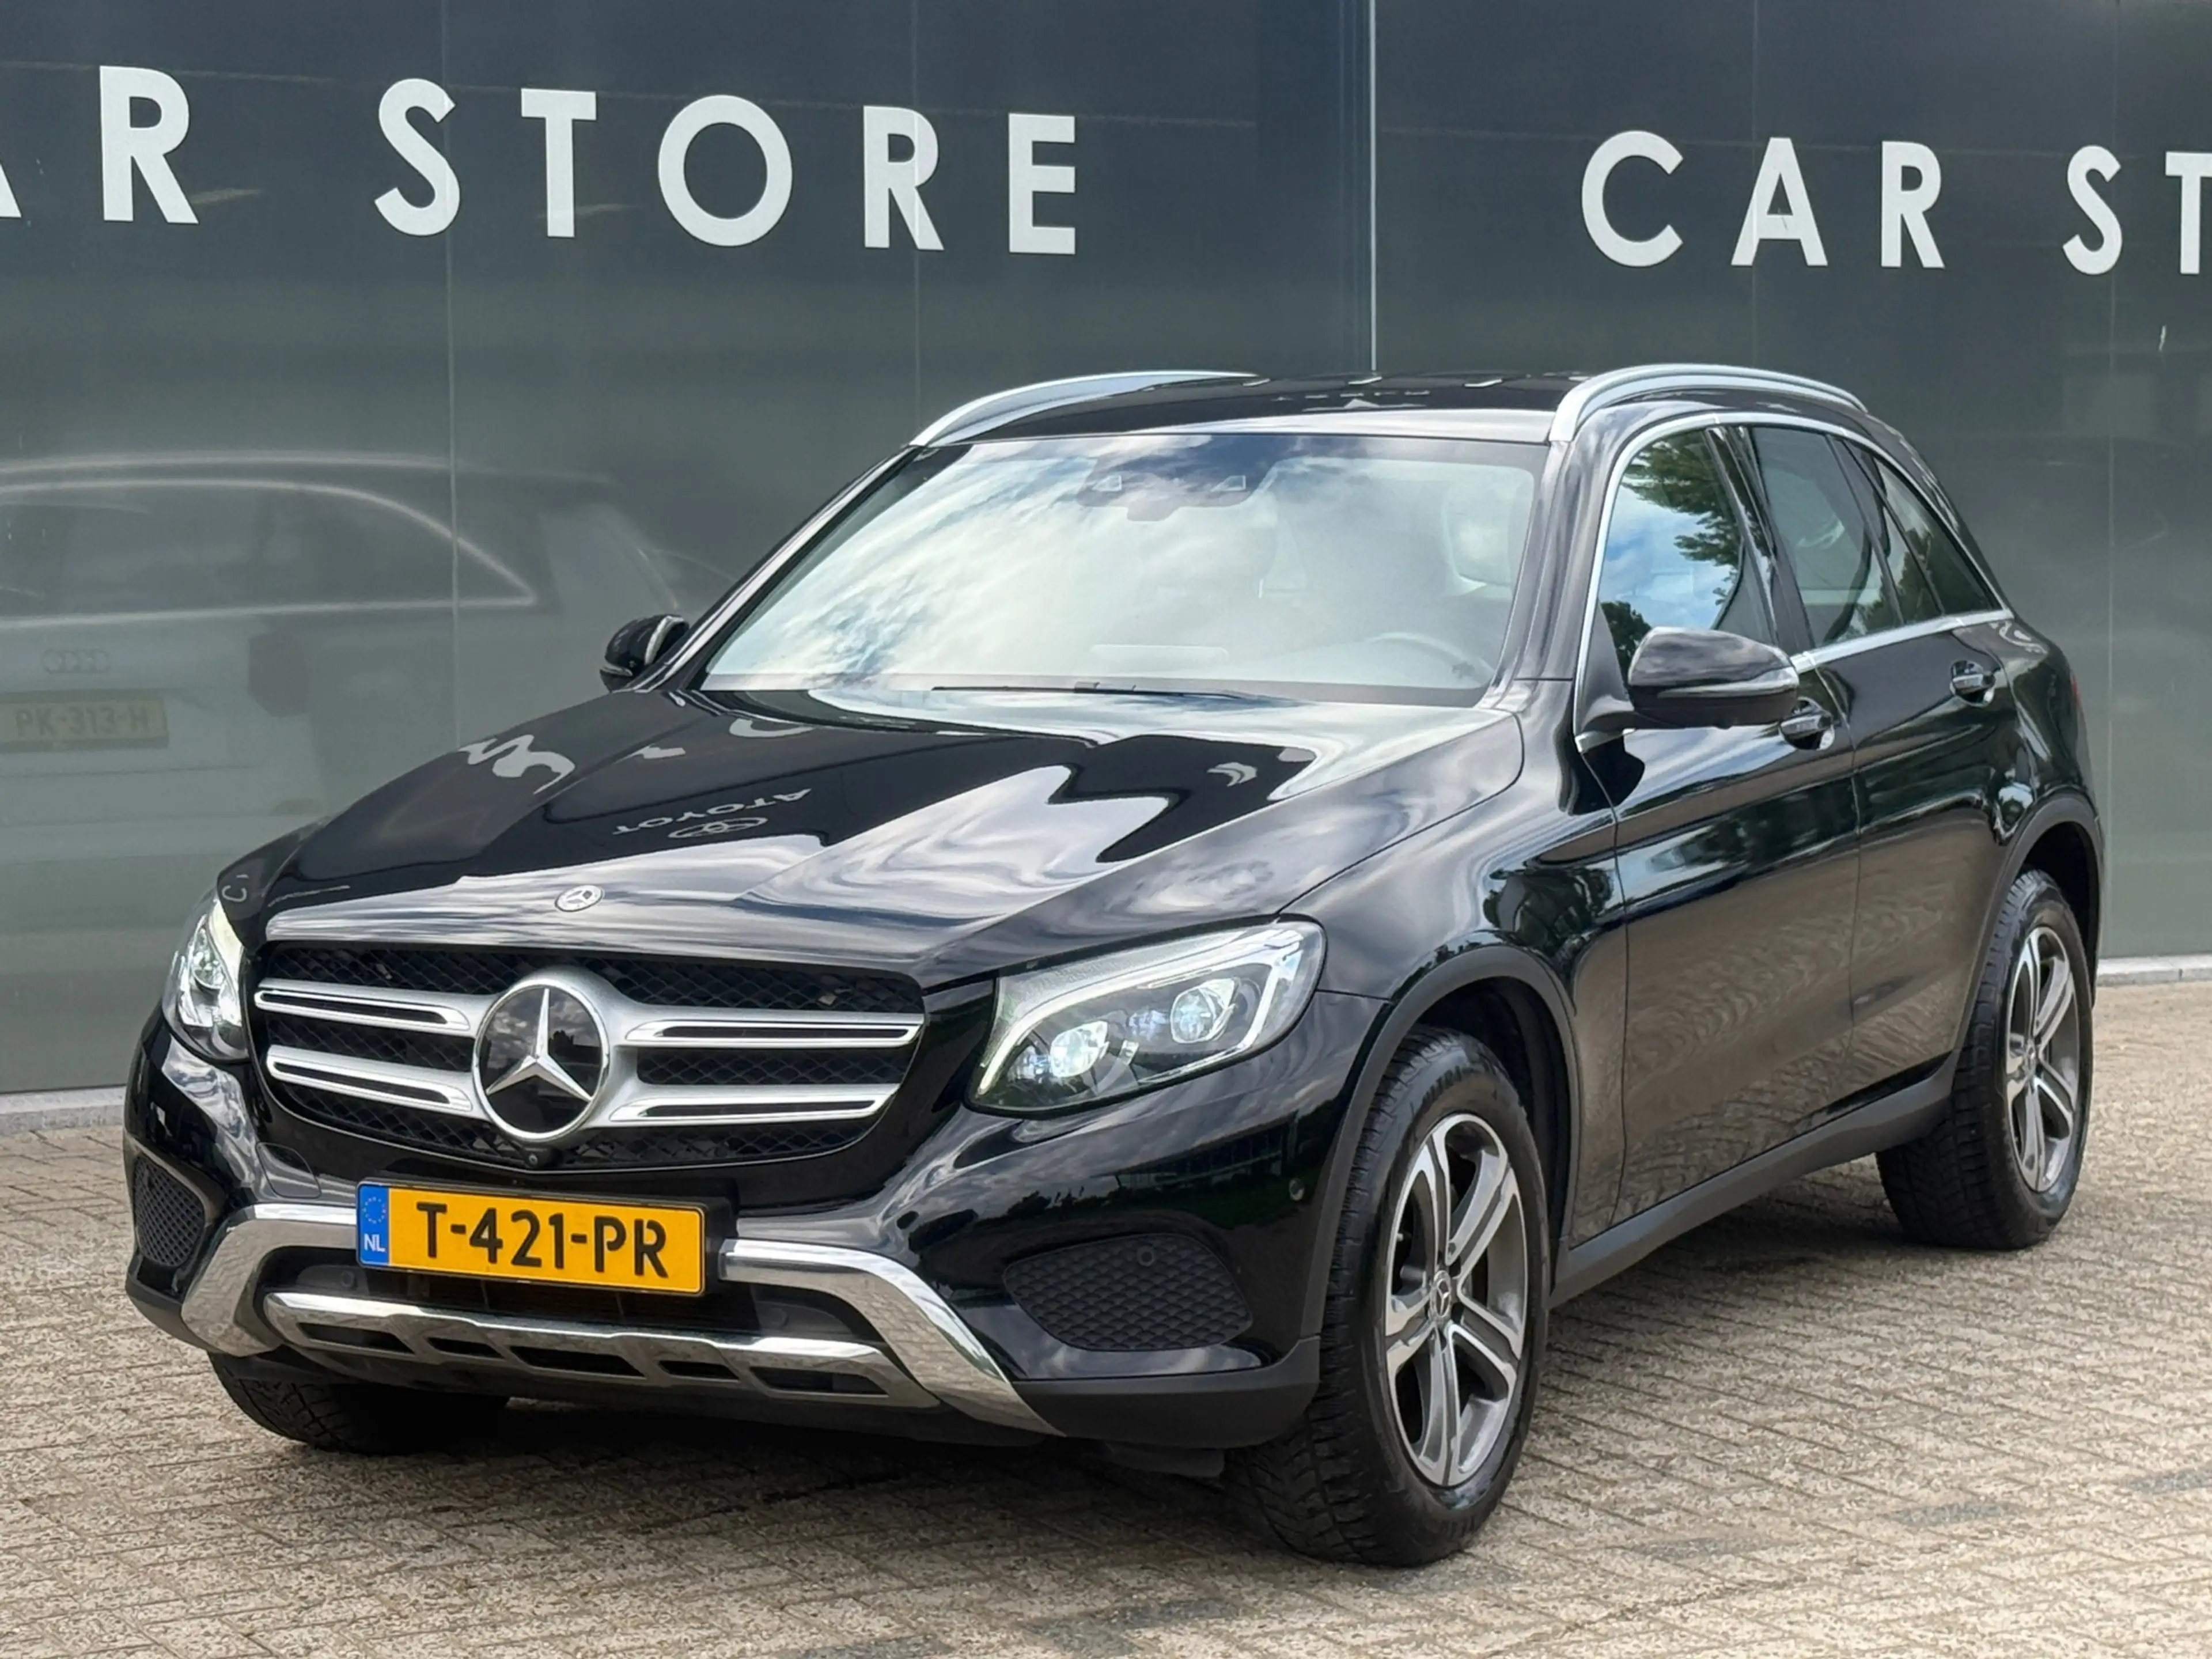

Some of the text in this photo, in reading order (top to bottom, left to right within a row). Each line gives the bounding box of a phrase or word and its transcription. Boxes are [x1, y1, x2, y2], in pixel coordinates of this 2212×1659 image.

[0, 65, 1076, 254] R STORE
[1582, 130, 2212, 275] CAR ST
[15, 705, 149, 737] PK-313-H
[364, 1202, 668, 1278] NL T-421-PR
